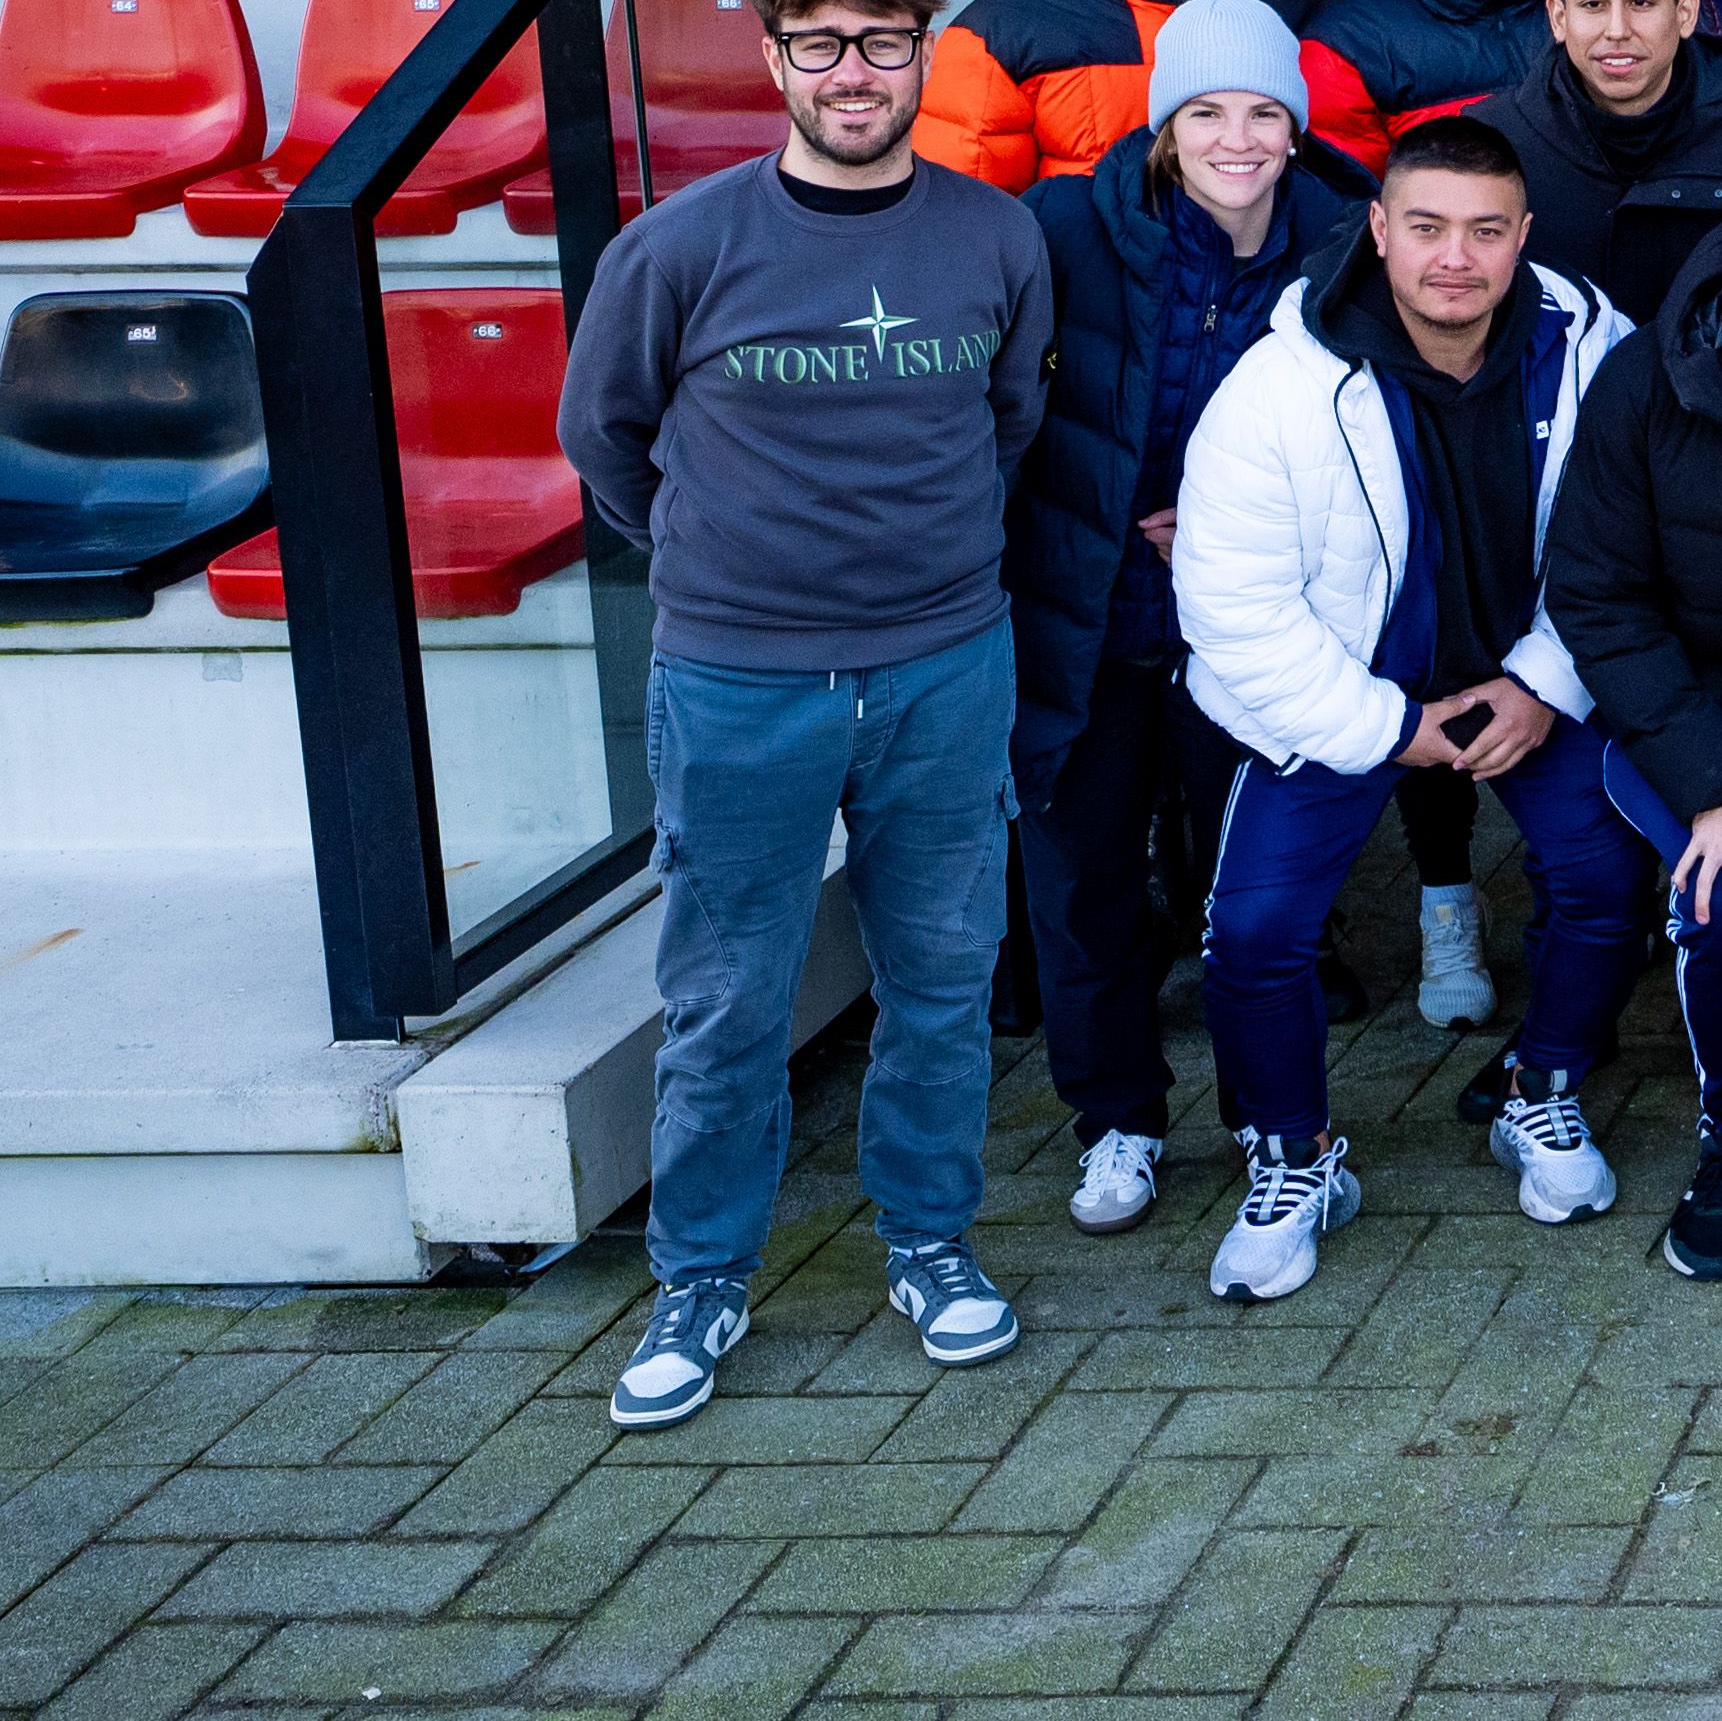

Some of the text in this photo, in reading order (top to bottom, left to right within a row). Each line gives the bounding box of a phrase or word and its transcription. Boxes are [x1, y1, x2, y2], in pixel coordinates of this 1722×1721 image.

[116, 0, 132, 11] 64
[419, 0, 434, 10] 65
[133, 328, 150, 339] 65
[478, 325, 496, 336] 66
[724, 345, 868, 383] STONE
